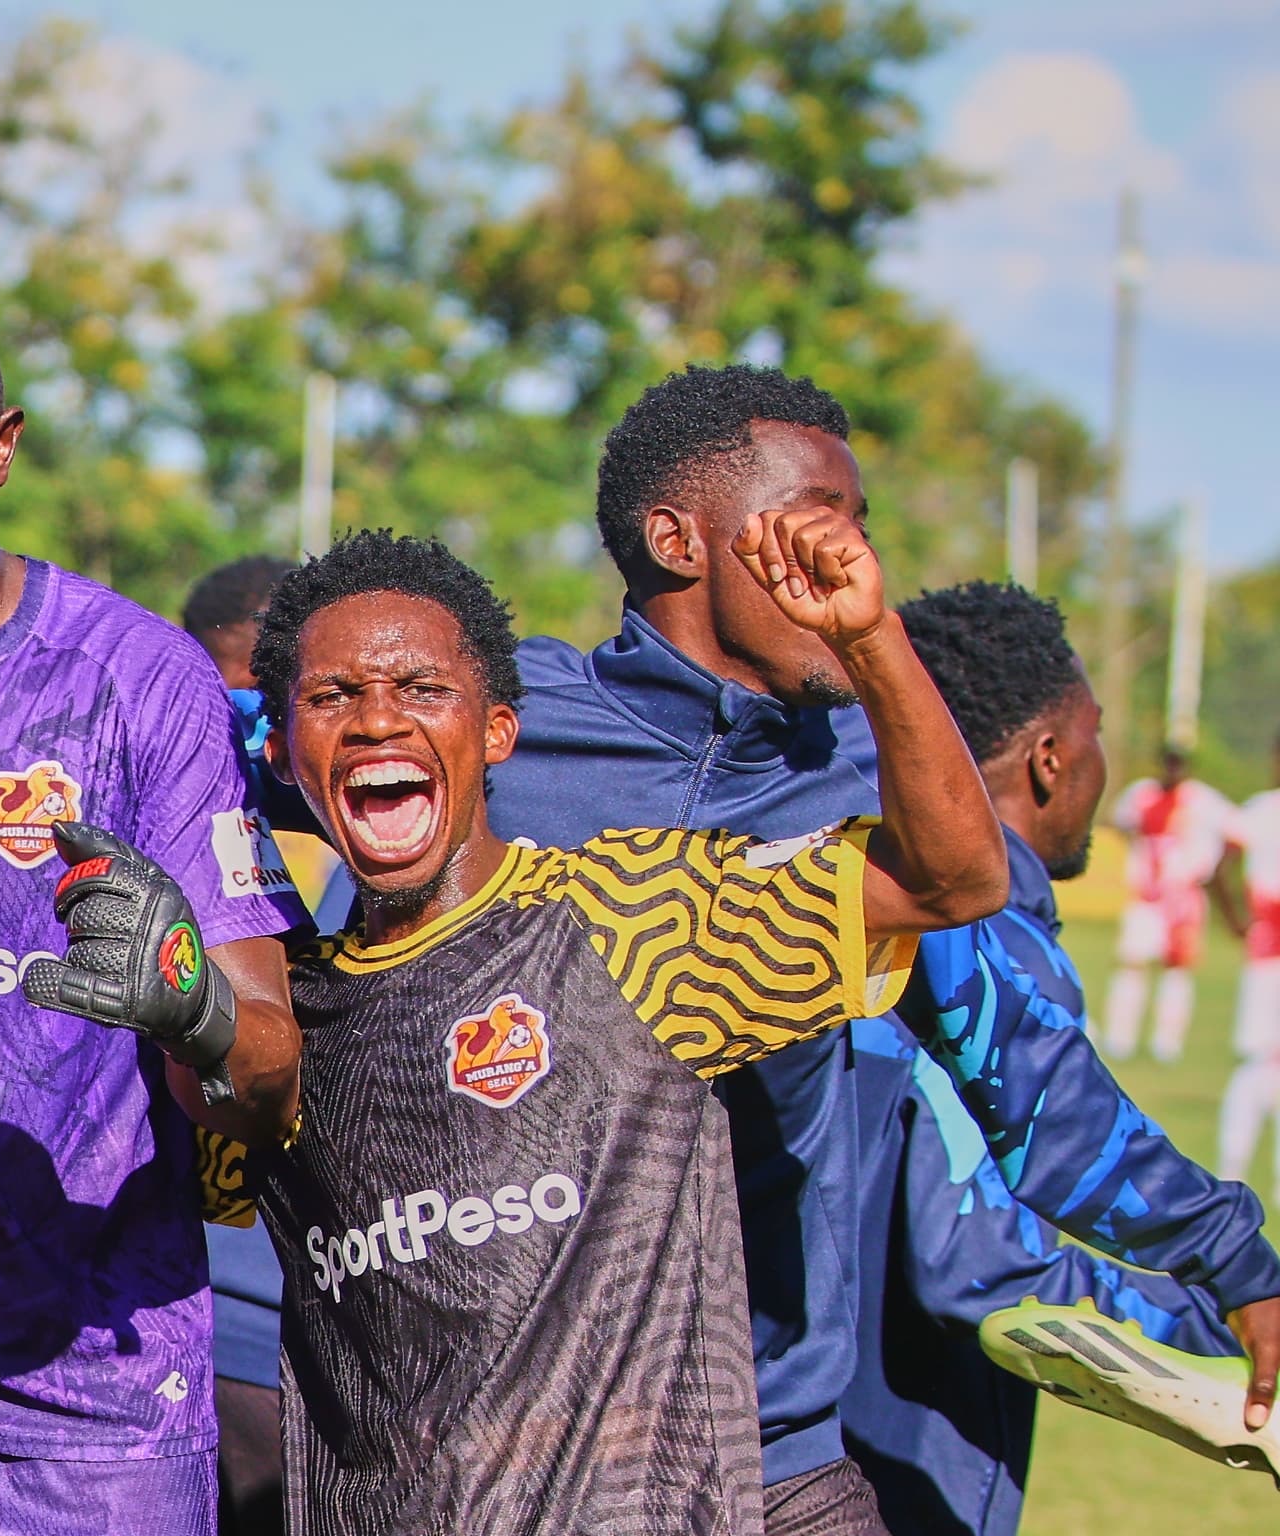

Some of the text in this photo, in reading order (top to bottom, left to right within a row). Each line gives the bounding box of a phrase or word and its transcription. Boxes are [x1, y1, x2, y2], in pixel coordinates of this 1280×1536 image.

[14, 839, 43, 849] SEAL
[465, 1060, 537, 1083] MURANG'A
[487, 1076, 516, 1089] SEAL
[306, 1173, 581, 1304] SportPesa
